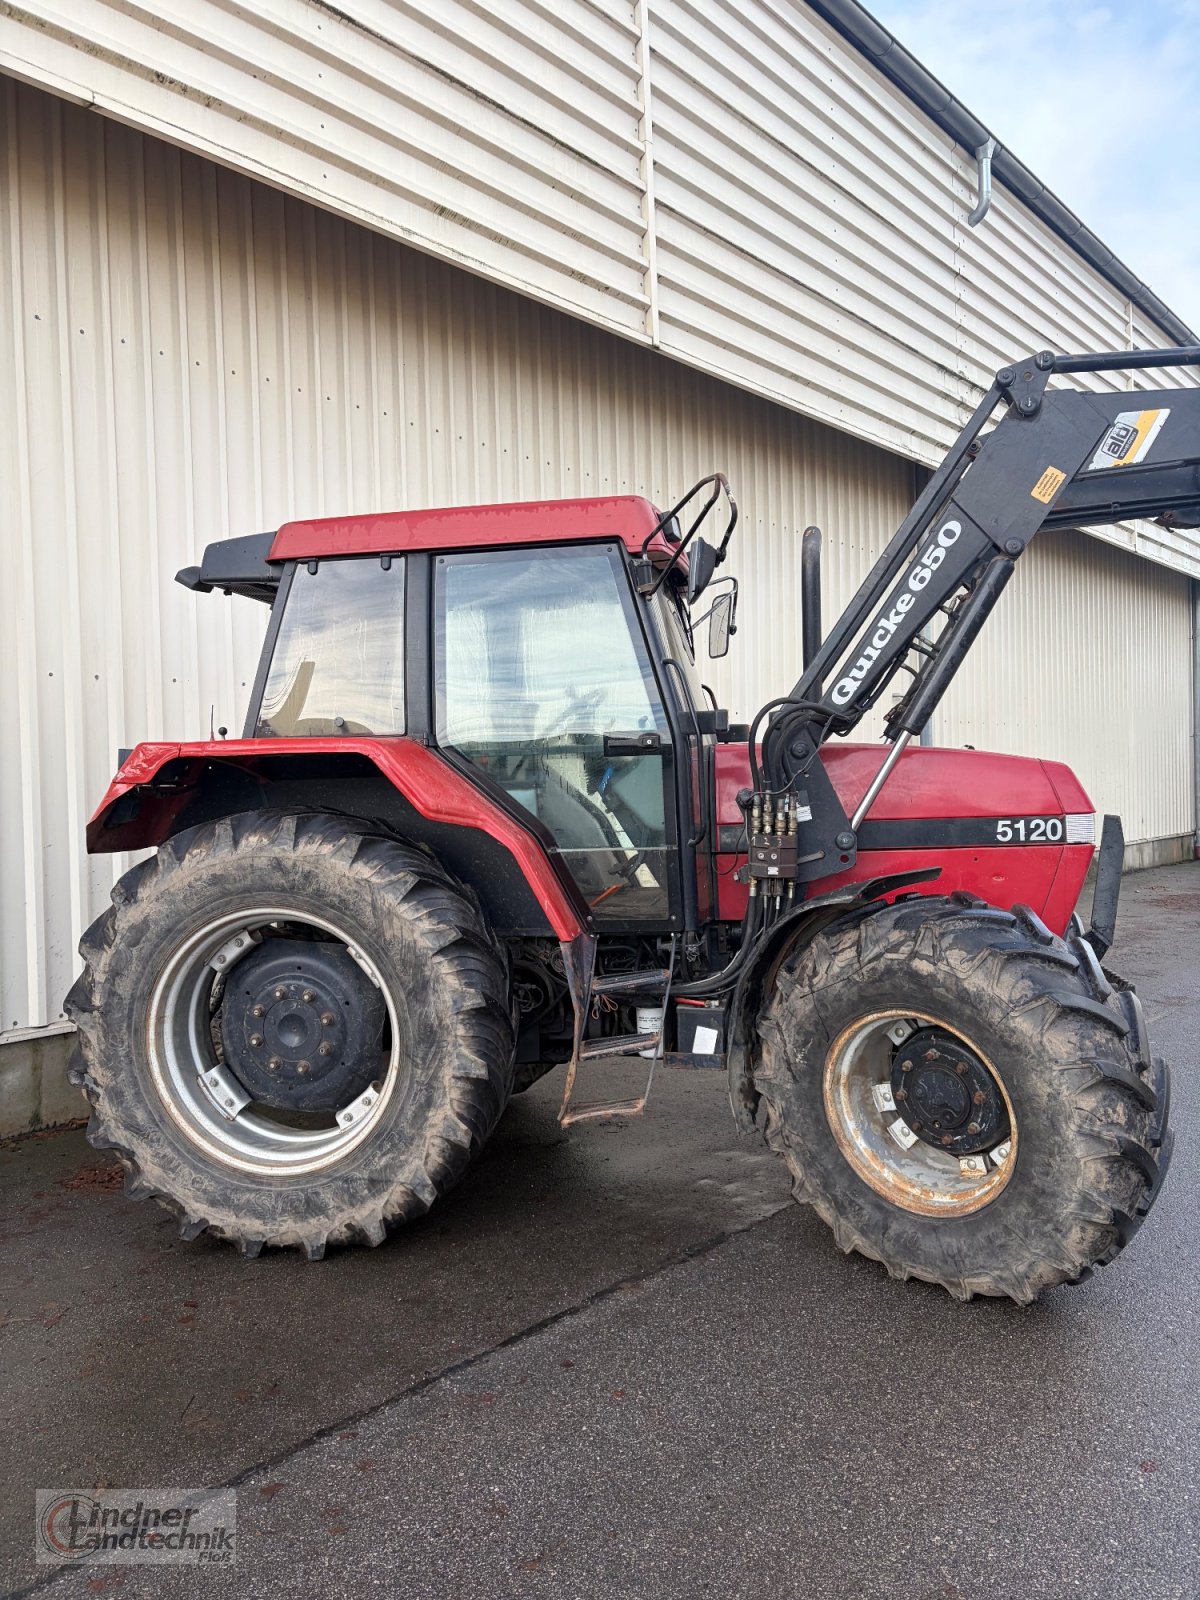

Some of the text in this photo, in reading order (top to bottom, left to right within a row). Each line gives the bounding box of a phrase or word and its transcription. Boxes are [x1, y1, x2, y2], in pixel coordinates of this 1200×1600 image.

[831, 520, 962, 705] Quicke 650
[996, 818, 1063, 842] 5120
